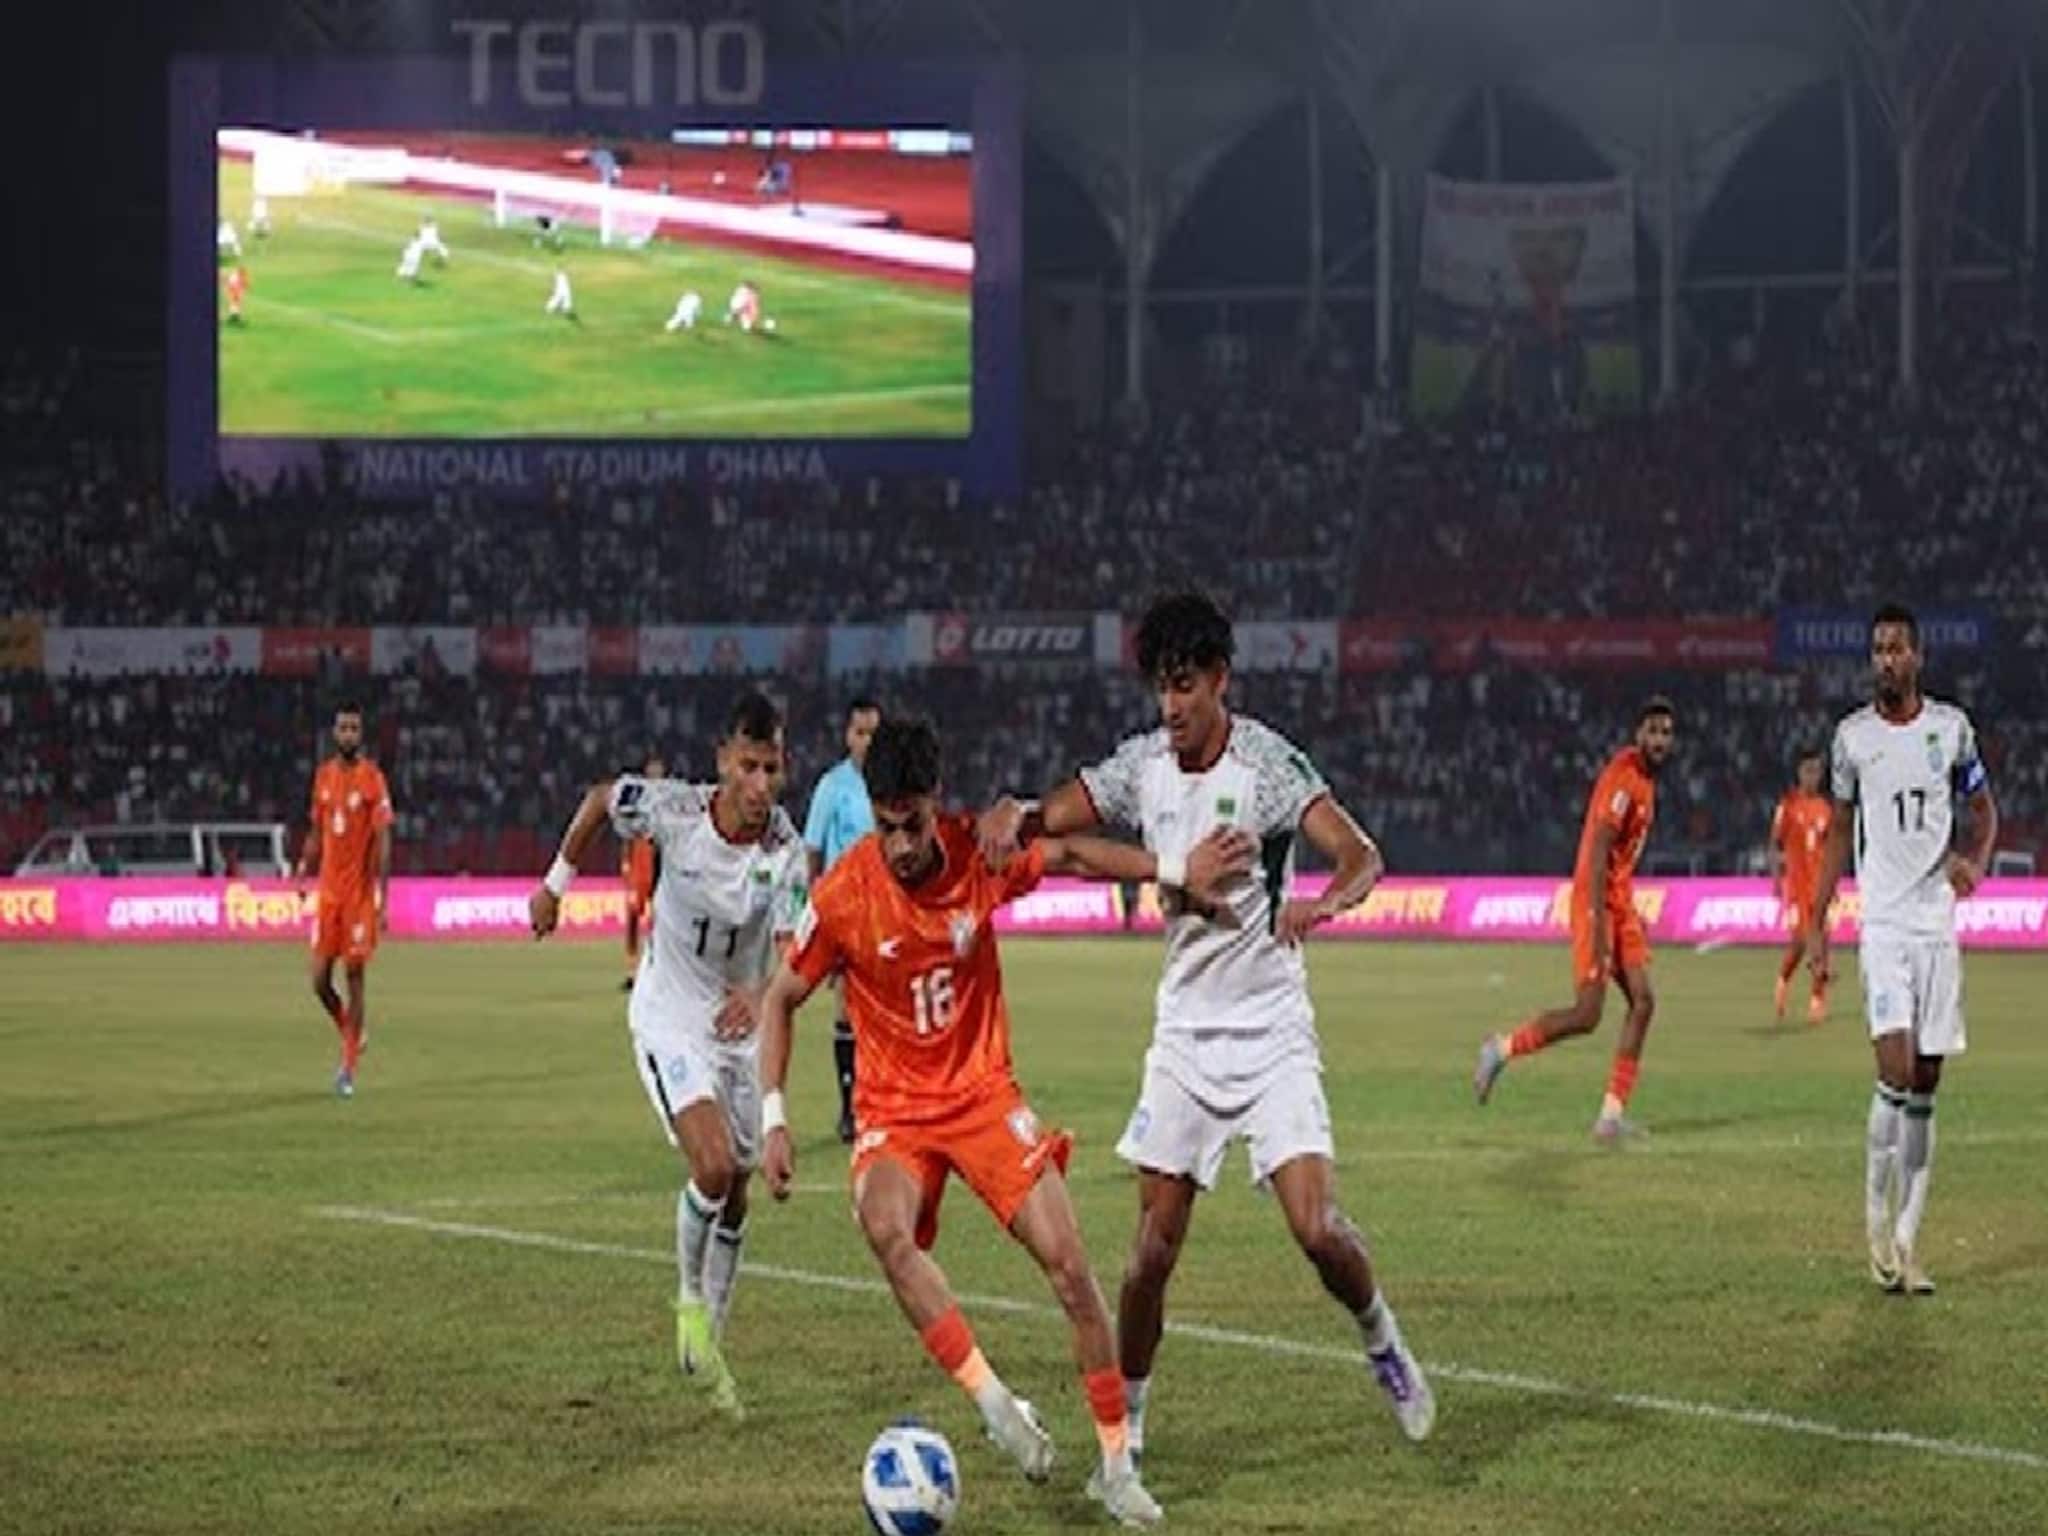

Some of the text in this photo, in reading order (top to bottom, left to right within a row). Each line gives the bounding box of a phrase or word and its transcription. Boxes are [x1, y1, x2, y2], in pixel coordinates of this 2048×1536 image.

[451, 19, 765, 107] TECNO
[971, 624, 1083, 650] LOTTO
[1893, 789, 1925, 832] 17
[691, 916, 740, 959] 11
[909, 967, 956, 1034] 16
